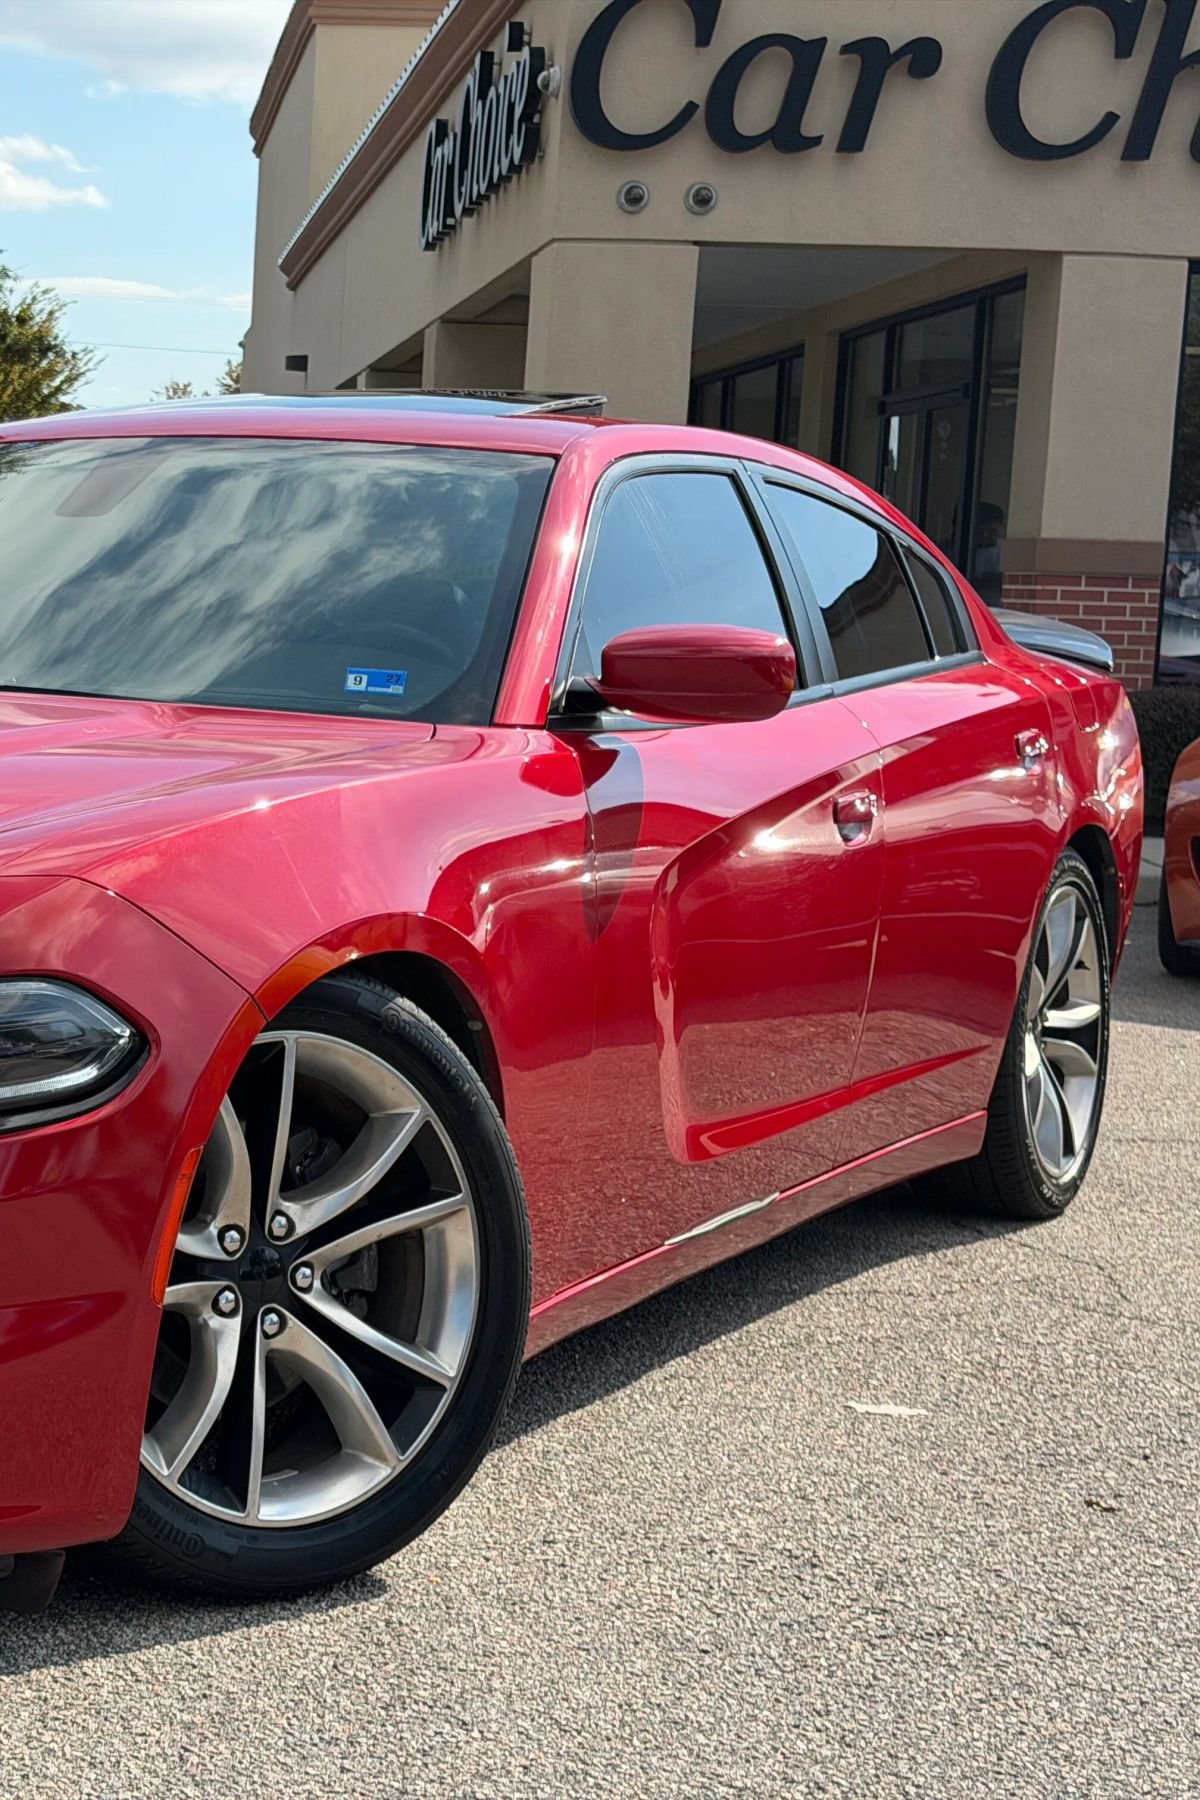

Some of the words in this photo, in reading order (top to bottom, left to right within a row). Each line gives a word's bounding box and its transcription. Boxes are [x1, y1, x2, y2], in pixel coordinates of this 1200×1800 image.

[420, 118, 455, 251] Car
[453, 21, 537, 219] Choice
[569, 0, 943, 154] Car
[353, 675, 363, 686] 9
[386, 674, 402, 684] 27
